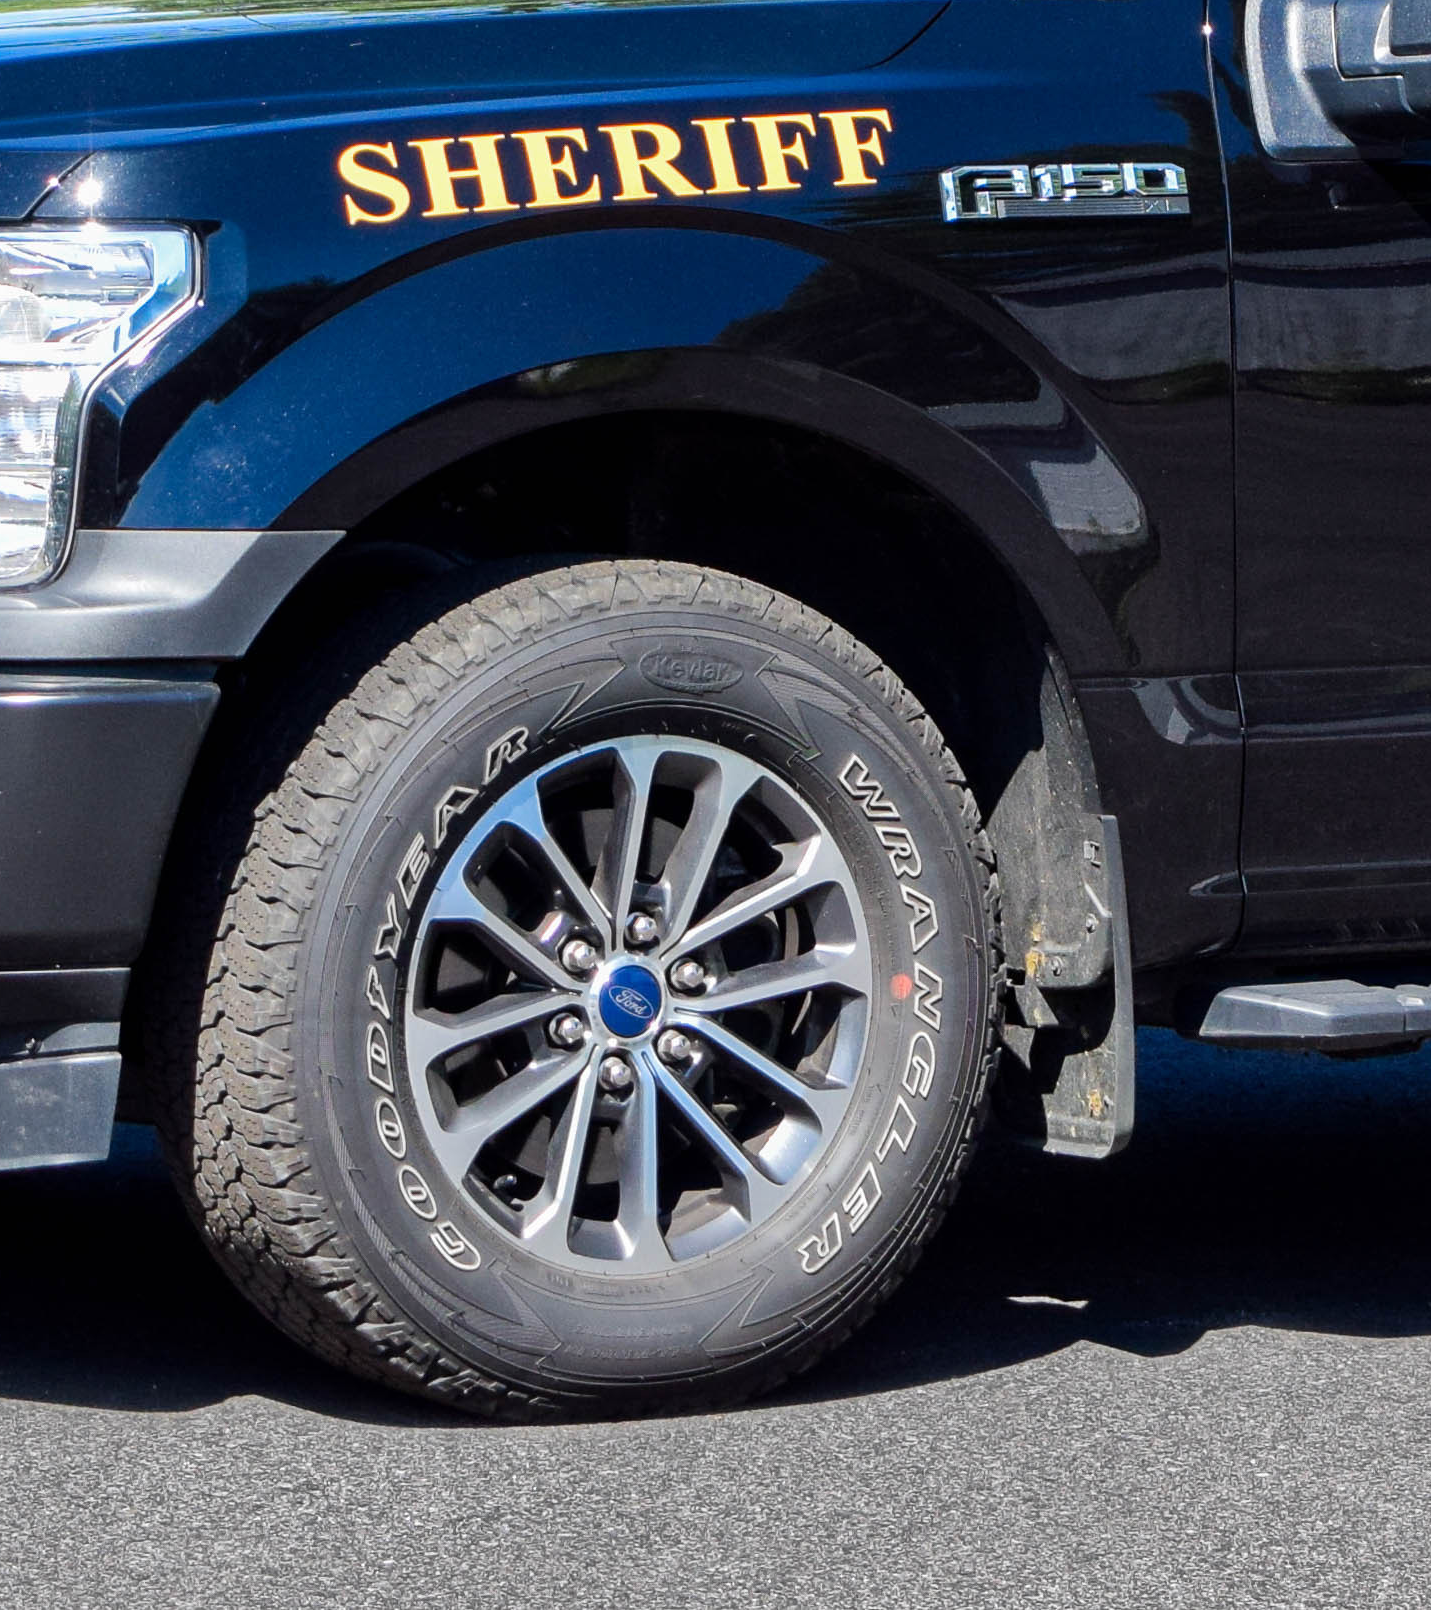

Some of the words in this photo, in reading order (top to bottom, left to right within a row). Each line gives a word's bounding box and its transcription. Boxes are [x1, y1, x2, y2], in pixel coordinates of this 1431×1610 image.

[337, 108, 894, 226] SHERIFF
[366, 726, 530, 1272] GOODYEAR
[615, 990, 648, 1015] Ford
[795, 754, 945, 1274] WRANGLER
